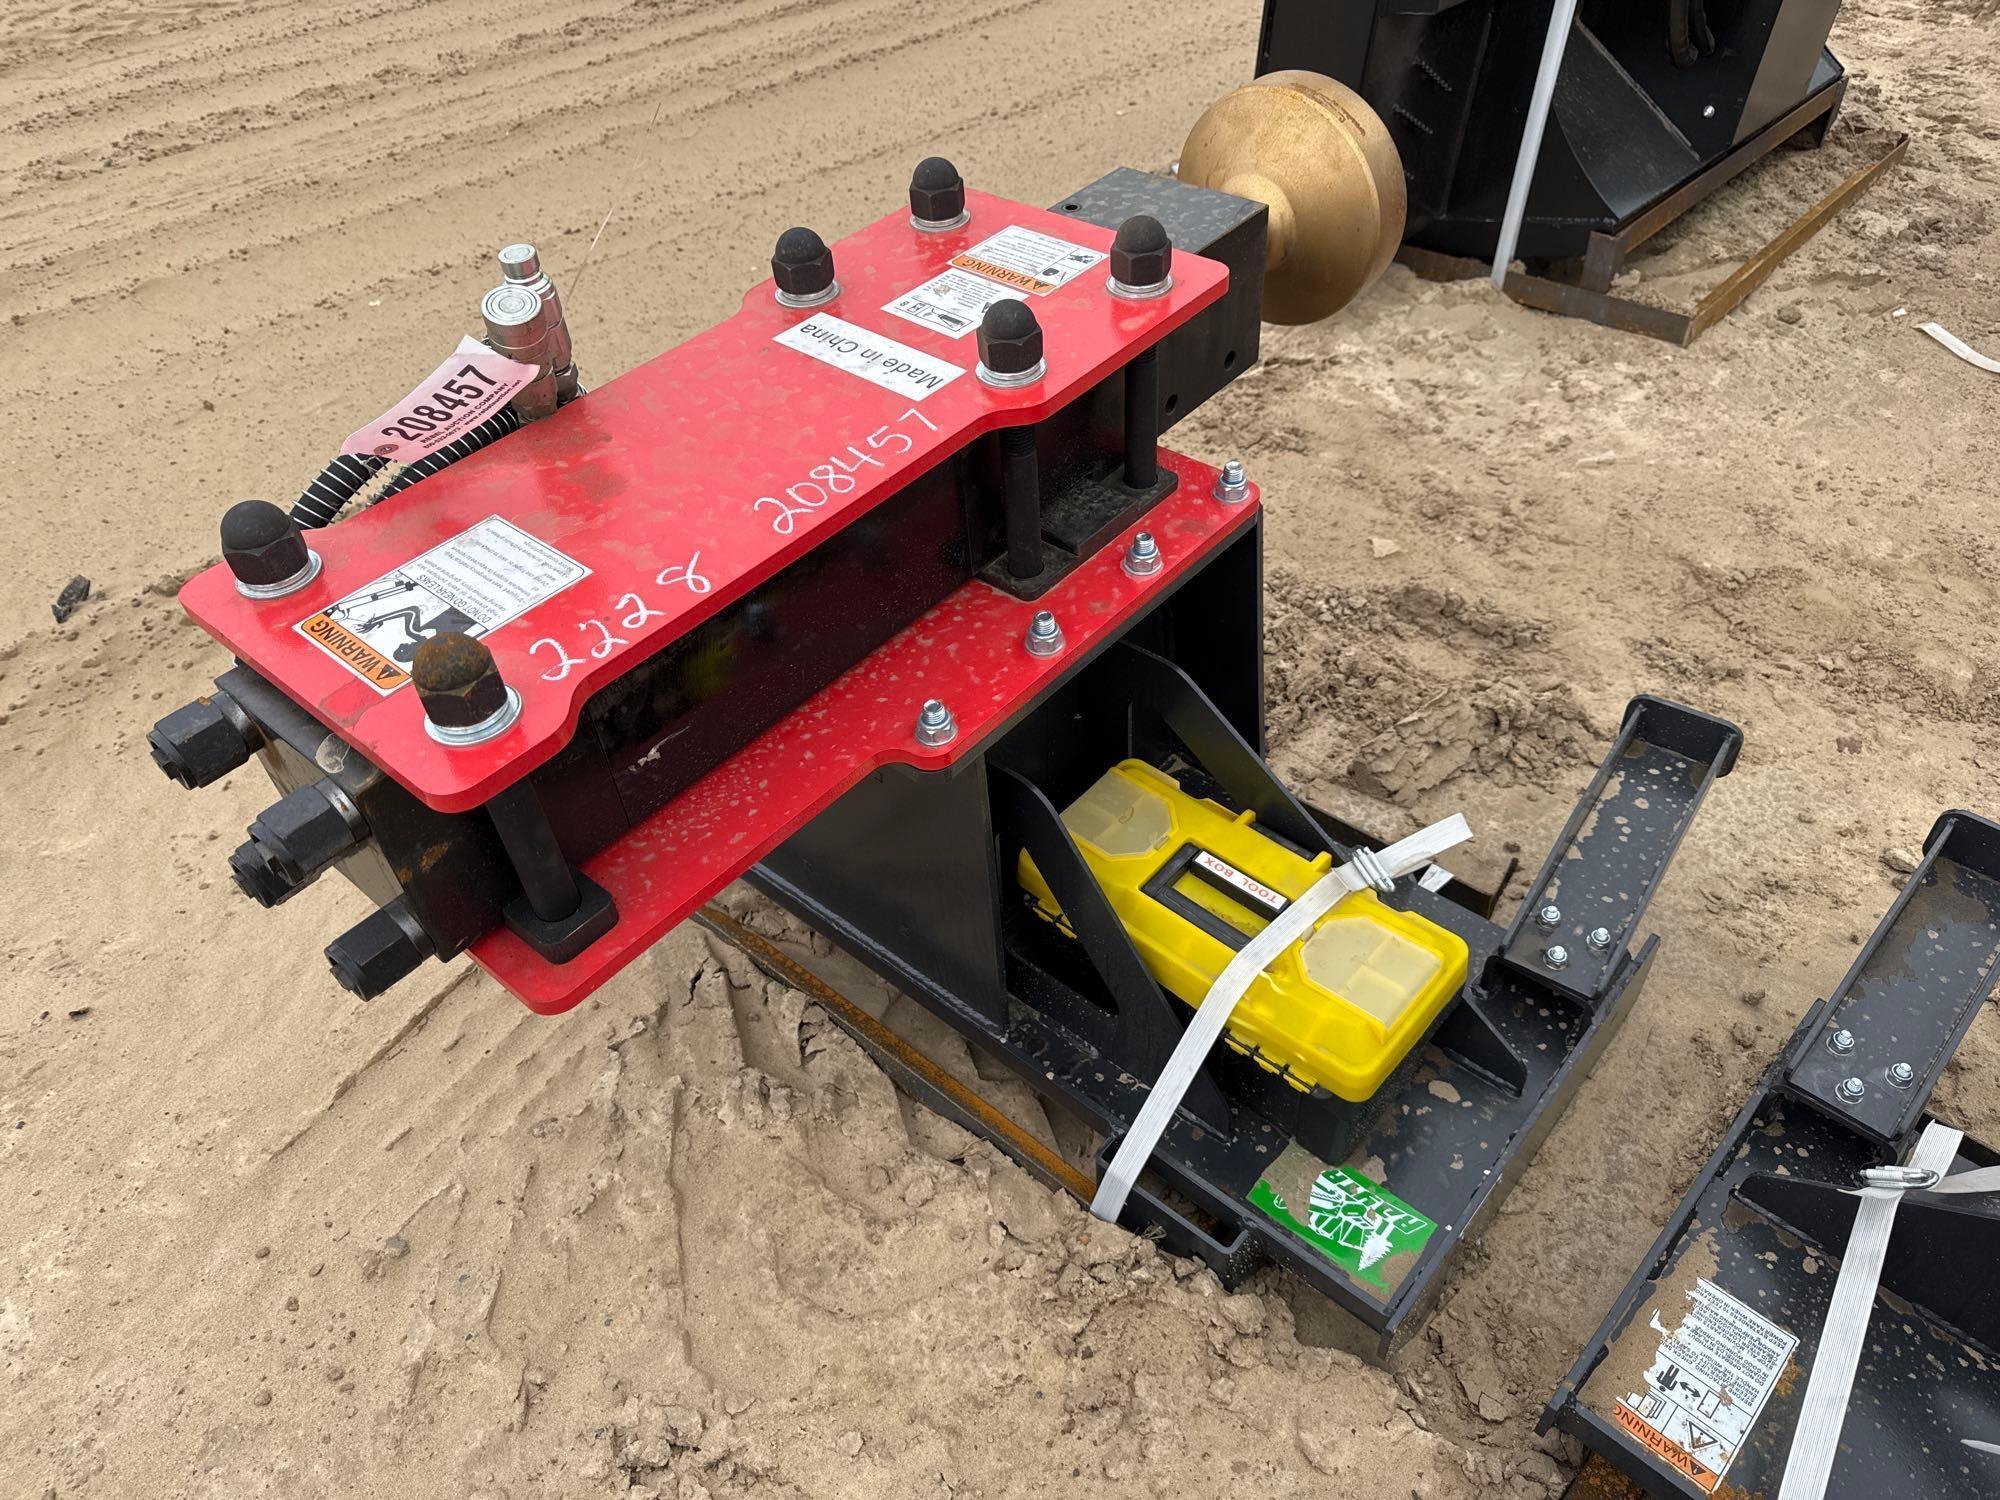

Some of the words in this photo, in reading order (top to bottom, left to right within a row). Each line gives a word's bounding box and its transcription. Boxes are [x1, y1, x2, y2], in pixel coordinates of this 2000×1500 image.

[960, 258, 1032, 286] WARNING
[801, 324, 859, 352] China
[862, 349, 884, 364] in
[883, 358, 944, 389] Made
[382, 364, 497, 441] 208457
[445, 407, 475, 431] AUCTION
[475, 383, 508, 409] COMPANY
[753, 409, 938, 534] 208457
[415, 573, 441, 590] LEAKS
[433, 585, 458, 601] NEAR
[451, 597, 468, 607] GO
[461, 603, 482, 616] NOT
[307, 618, 384, 672] WARNING
[1202, 855, 1237, 881] BOX
[1240, 876, 1280, 906] TOOL
[1695, 1282, 1723, 1304] OPERATIO
[1707, 1296, 1722, 1308] FEET
[1683, 1291, 1719, 1316] MAINTENAN
[1694, 1309, 1716, 1326] ENGINE
[1730, 1306, 1748, 1320] WHEN
[1702, 1320, 1721, 1335] PARTS
[1718, 1314, 1757, 1342] PERFORMING
[1729, 1311, 1768, 1339] BYSTANDERS
[1747, 1317, 1764, 1331] RAKE
[1687, 1331, 1714, 1352] WITHOUT
[1716, 1324, 1741, 1343] LOADER
[1721, 1333, 1745, 1351] MOVING
[1764, 1328, 1787, 1346] POWER
[1668, 1340, 1697, 1362] CAPACITY
[1715, 1339, 1743, 1360] WORKING
[1741, 1340, 1761, 1356] STEER
[1768, 1336, 1784, 1350] KEEP
[1672, 1348, 1692, 1365] CHECK
[1690, 1350, 1699, 1358] TO
[1714, 1350, 1741, 1371] OPERATE
[1746, 1349, 1757, 1359] ALL
[1756, 1356, 1773, 1370] STOP
[1760, 1354, 1775, 1366] SKID
[1697, 1360, 1710, 1371] LIFT
[1699, 1356, 1722, 1374] ABILITY
[1722, 1366, 1734, 1377] THE
[1741, 1369, 1754, 1379] NOT
[1743, 1358, 1762, 1373] GOOD
[1710, 1369, 1735, 1388] LOADER
[1734, 1375, 1759, 1394] HANDLE
[1754, 1377, 1764, 1386] DO
[1727, 1387, 1752, 1406] BEFORE
[1732, 1379, 1757, 1398] ENSURE
[1734, 1386, 1754, 1402] STEER
